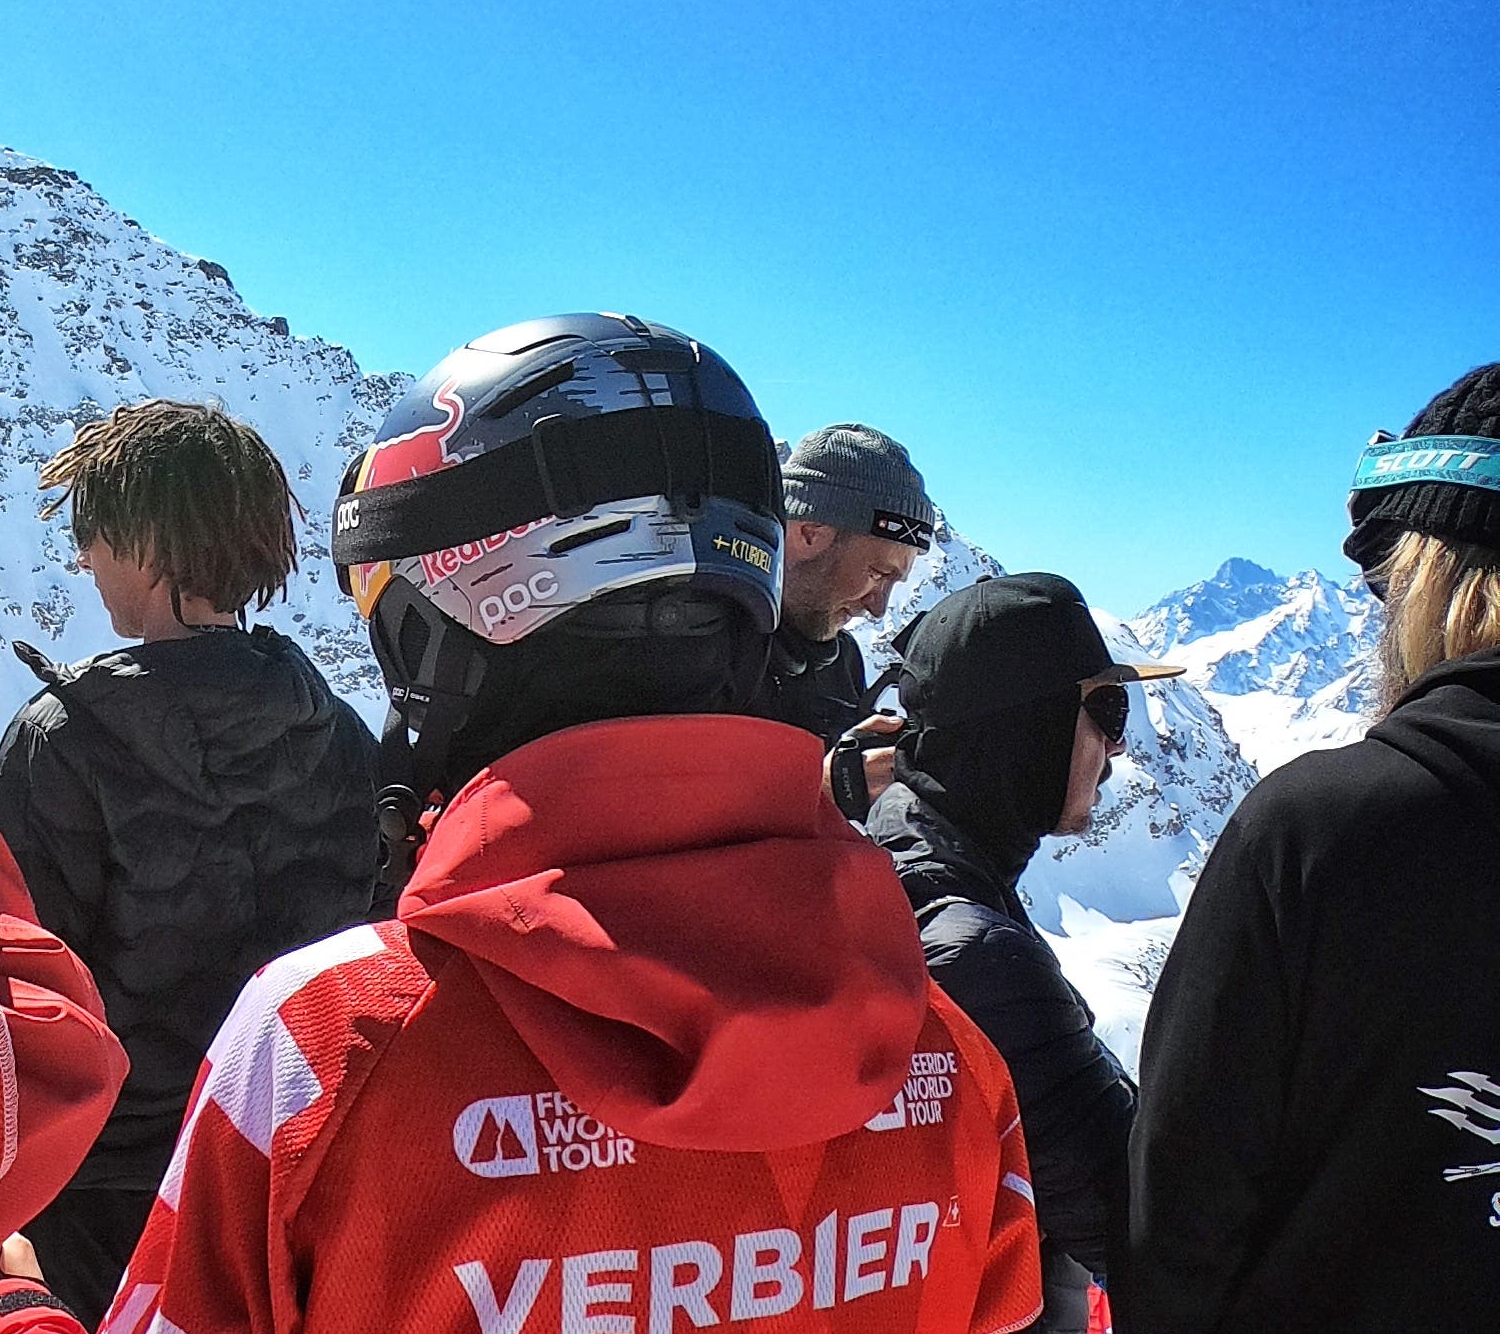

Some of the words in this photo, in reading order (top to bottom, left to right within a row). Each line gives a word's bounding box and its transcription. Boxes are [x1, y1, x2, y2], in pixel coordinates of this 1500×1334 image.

[1373, 449, 1490, 475] SCOTT
[904, 1076, 953, 1101] WORLD
[907, 1100, 944, 1127] TOUR
[543, 1138, 636, 1173] TOUR
